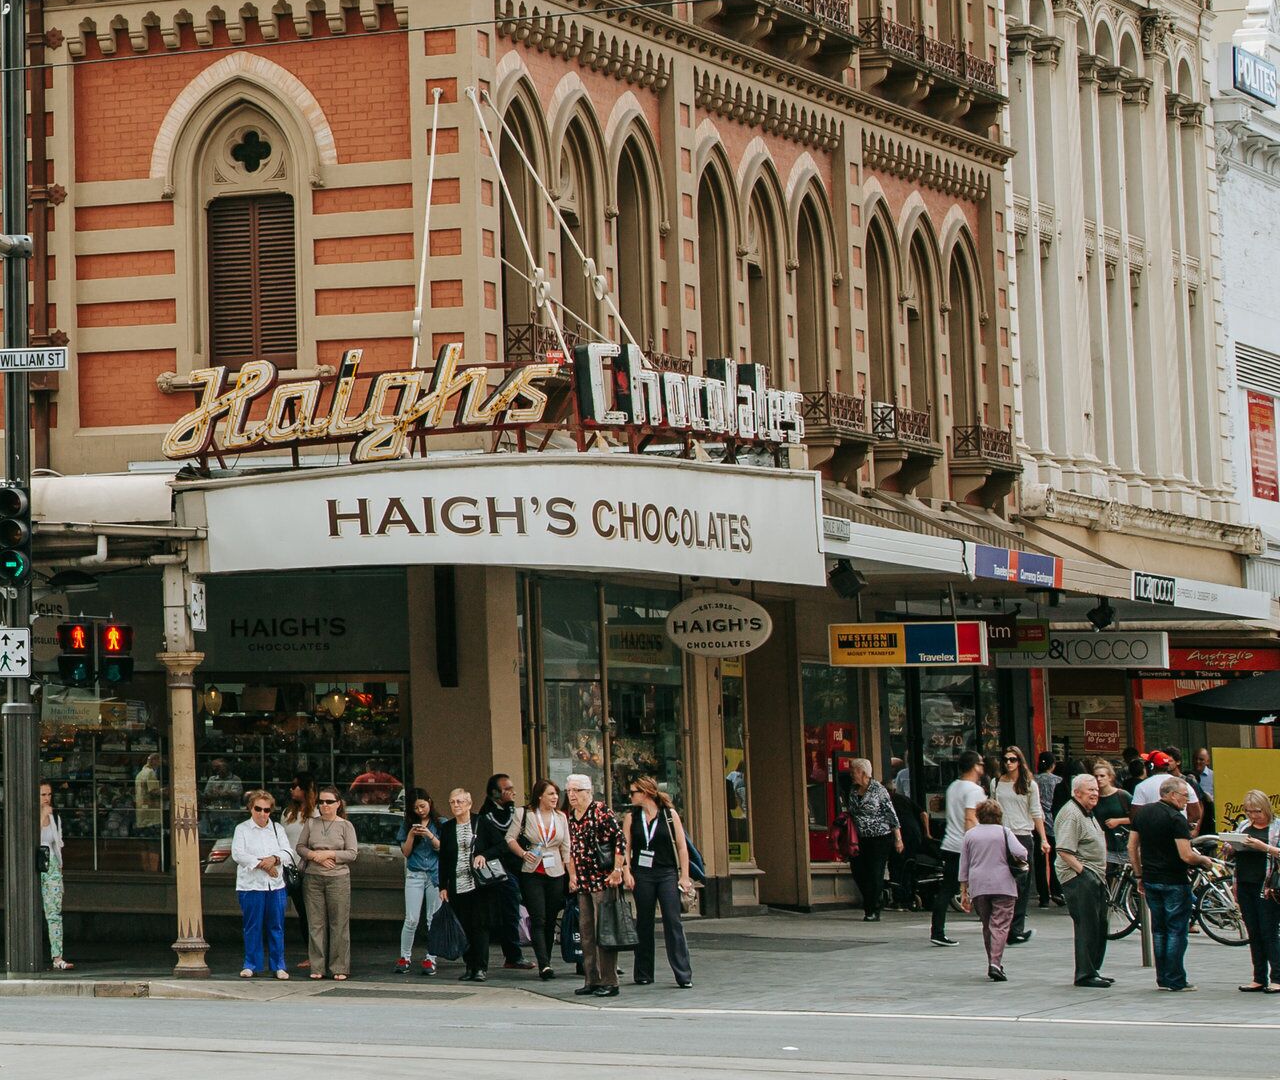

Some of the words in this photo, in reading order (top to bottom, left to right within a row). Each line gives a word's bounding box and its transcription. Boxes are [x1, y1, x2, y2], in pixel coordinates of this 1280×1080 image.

[0, 353, 45, 367] WILLIAM
[48, 352, 61, 366] ST
[326, 495, 578, 538] HAIGH'S
[591, 499, 753, 554] CHOCOLATES
[230, 617, 346, 637] HAIGH'S
[673, 617, 762, 634] HAIGH'S
[989, 625, 1011, 638] tm
[840, 634, 887, 642] WESTERN
[248, 643, 330, 651] CHOCOLATES
[687, 640, 751, 649] CHOCOLATES
[918, 653, 955, 662] Travelex
[1187, 650, 1254, 661] Australia
